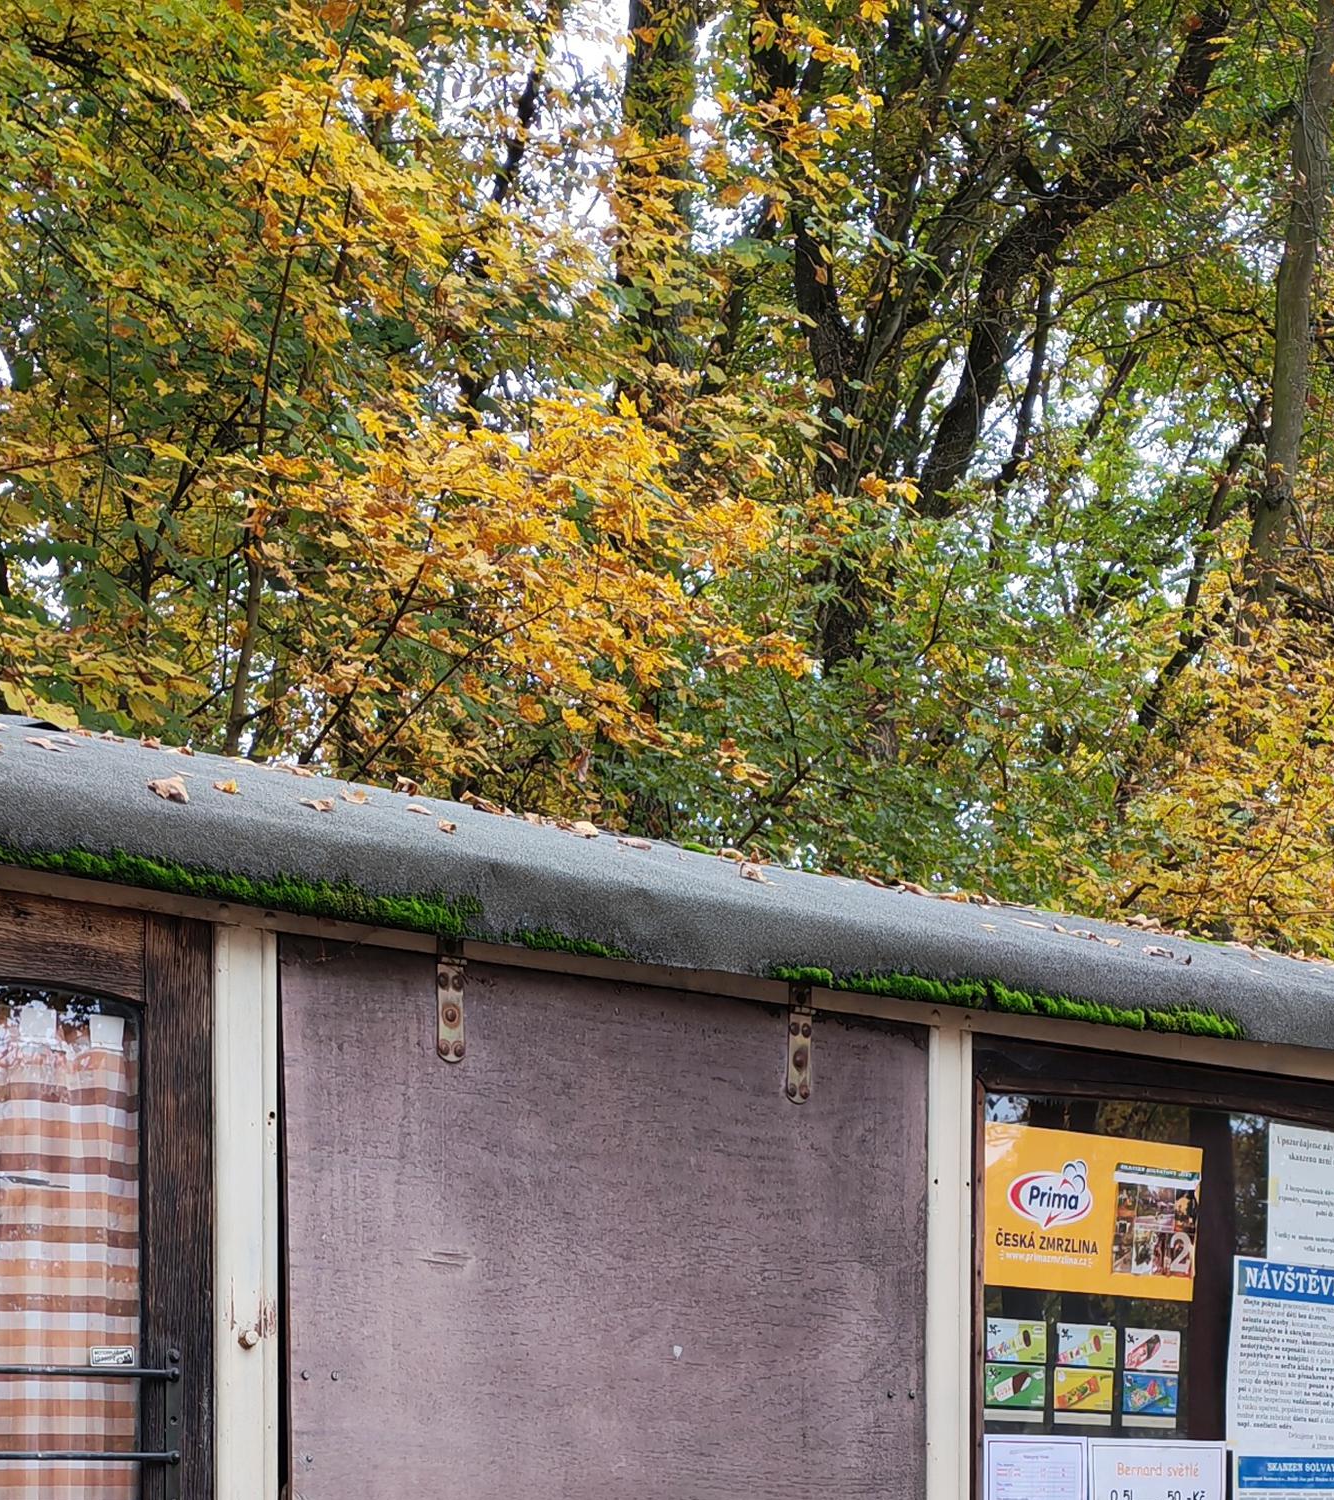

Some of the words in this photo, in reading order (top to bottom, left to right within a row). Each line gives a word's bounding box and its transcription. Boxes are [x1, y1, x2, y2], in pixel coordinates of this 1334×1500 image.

[1028, 1185, 1079, 1211] Prima
[995, 1228, 1035, 1248] ČESKÁ
[1039, 1236, 1099, 1255] ZMRZLINA
[1170, 1232, 1191, 1272] 2
[1117, 1462, 1163, 1476] Bernard
[1167, 1463, 1200, 1478] světlé
[1267, 1462, 1303, 1472] SKANZEN
